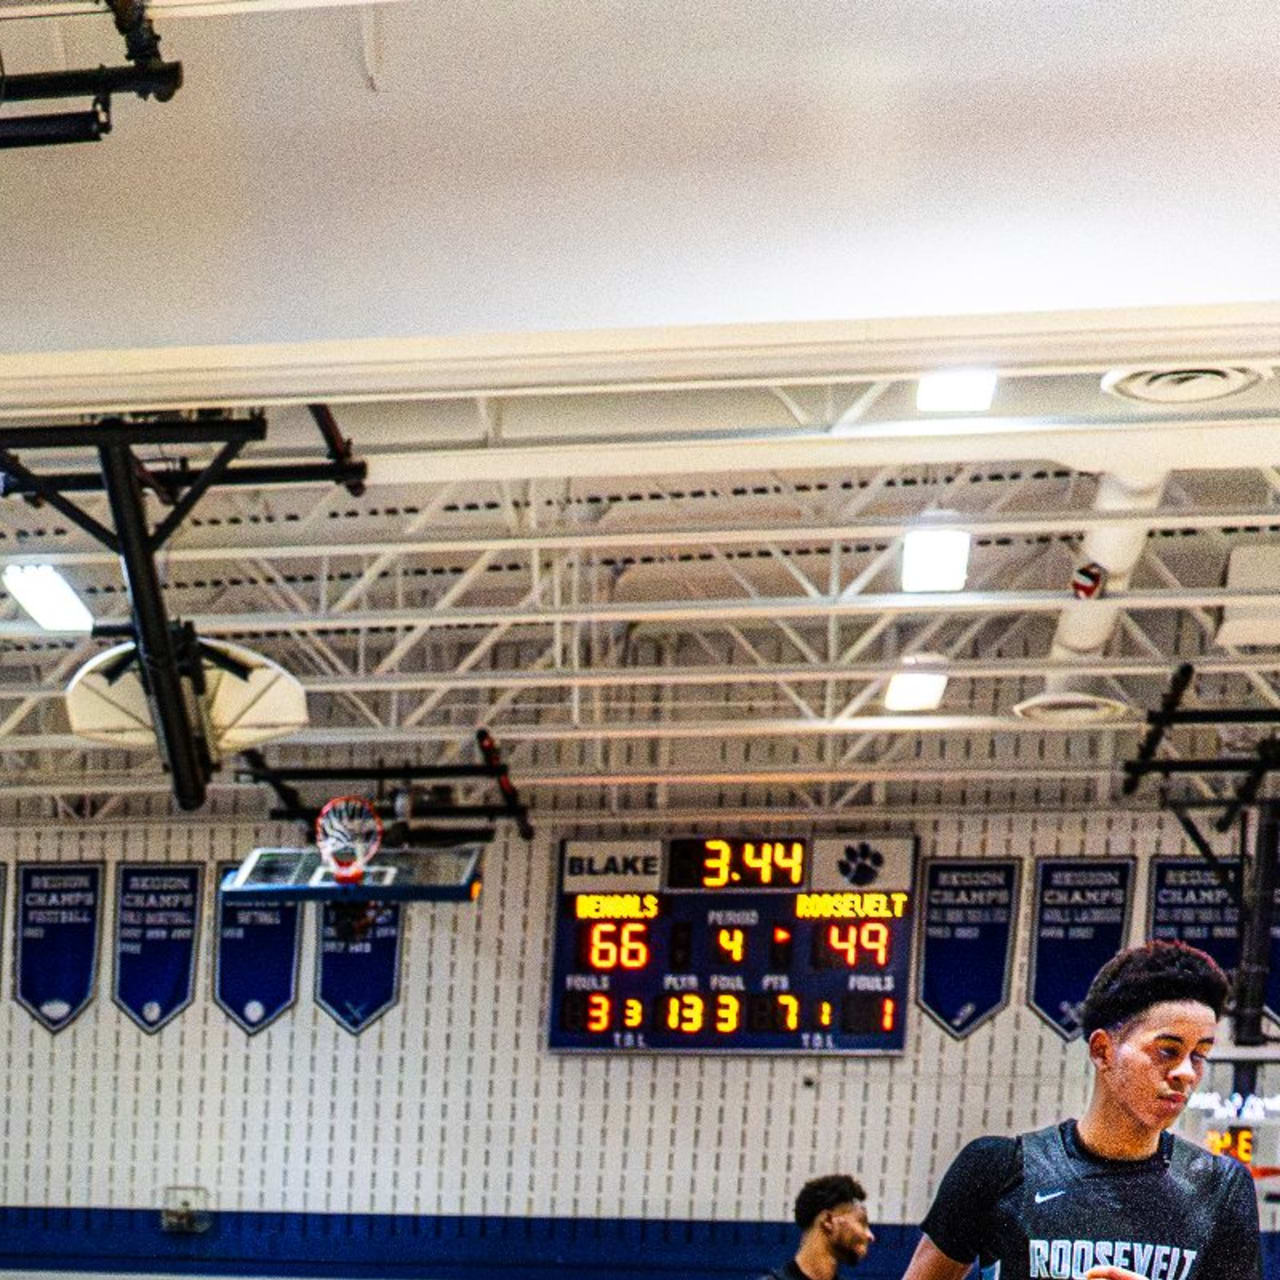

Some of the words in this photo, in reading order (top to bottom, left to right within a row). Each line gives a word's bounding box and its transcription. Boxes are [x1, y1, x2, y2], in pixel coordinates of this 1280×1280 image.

[568, 856, 658, 877] BLAKE
[708, 910, 759, 926] PERIOD
[591, 922, 648, 969] 66
[719, 929, 743, 962] 4
[829, 922, 888, 966] 49
[565, 974, 610, 991] FOULS
[848, 974, 895, 992] FOULS
[588, 993, 610, 1032] 3
[624, 999, 643, 1027] 3
[667, 994, 704, 1032] 13
[716, 994, 739, 1032] 3
[777, 994, 799, 1031] 7
[820, 1001, 831, 1026] 1
[882, 998, 894, 1031] 1
